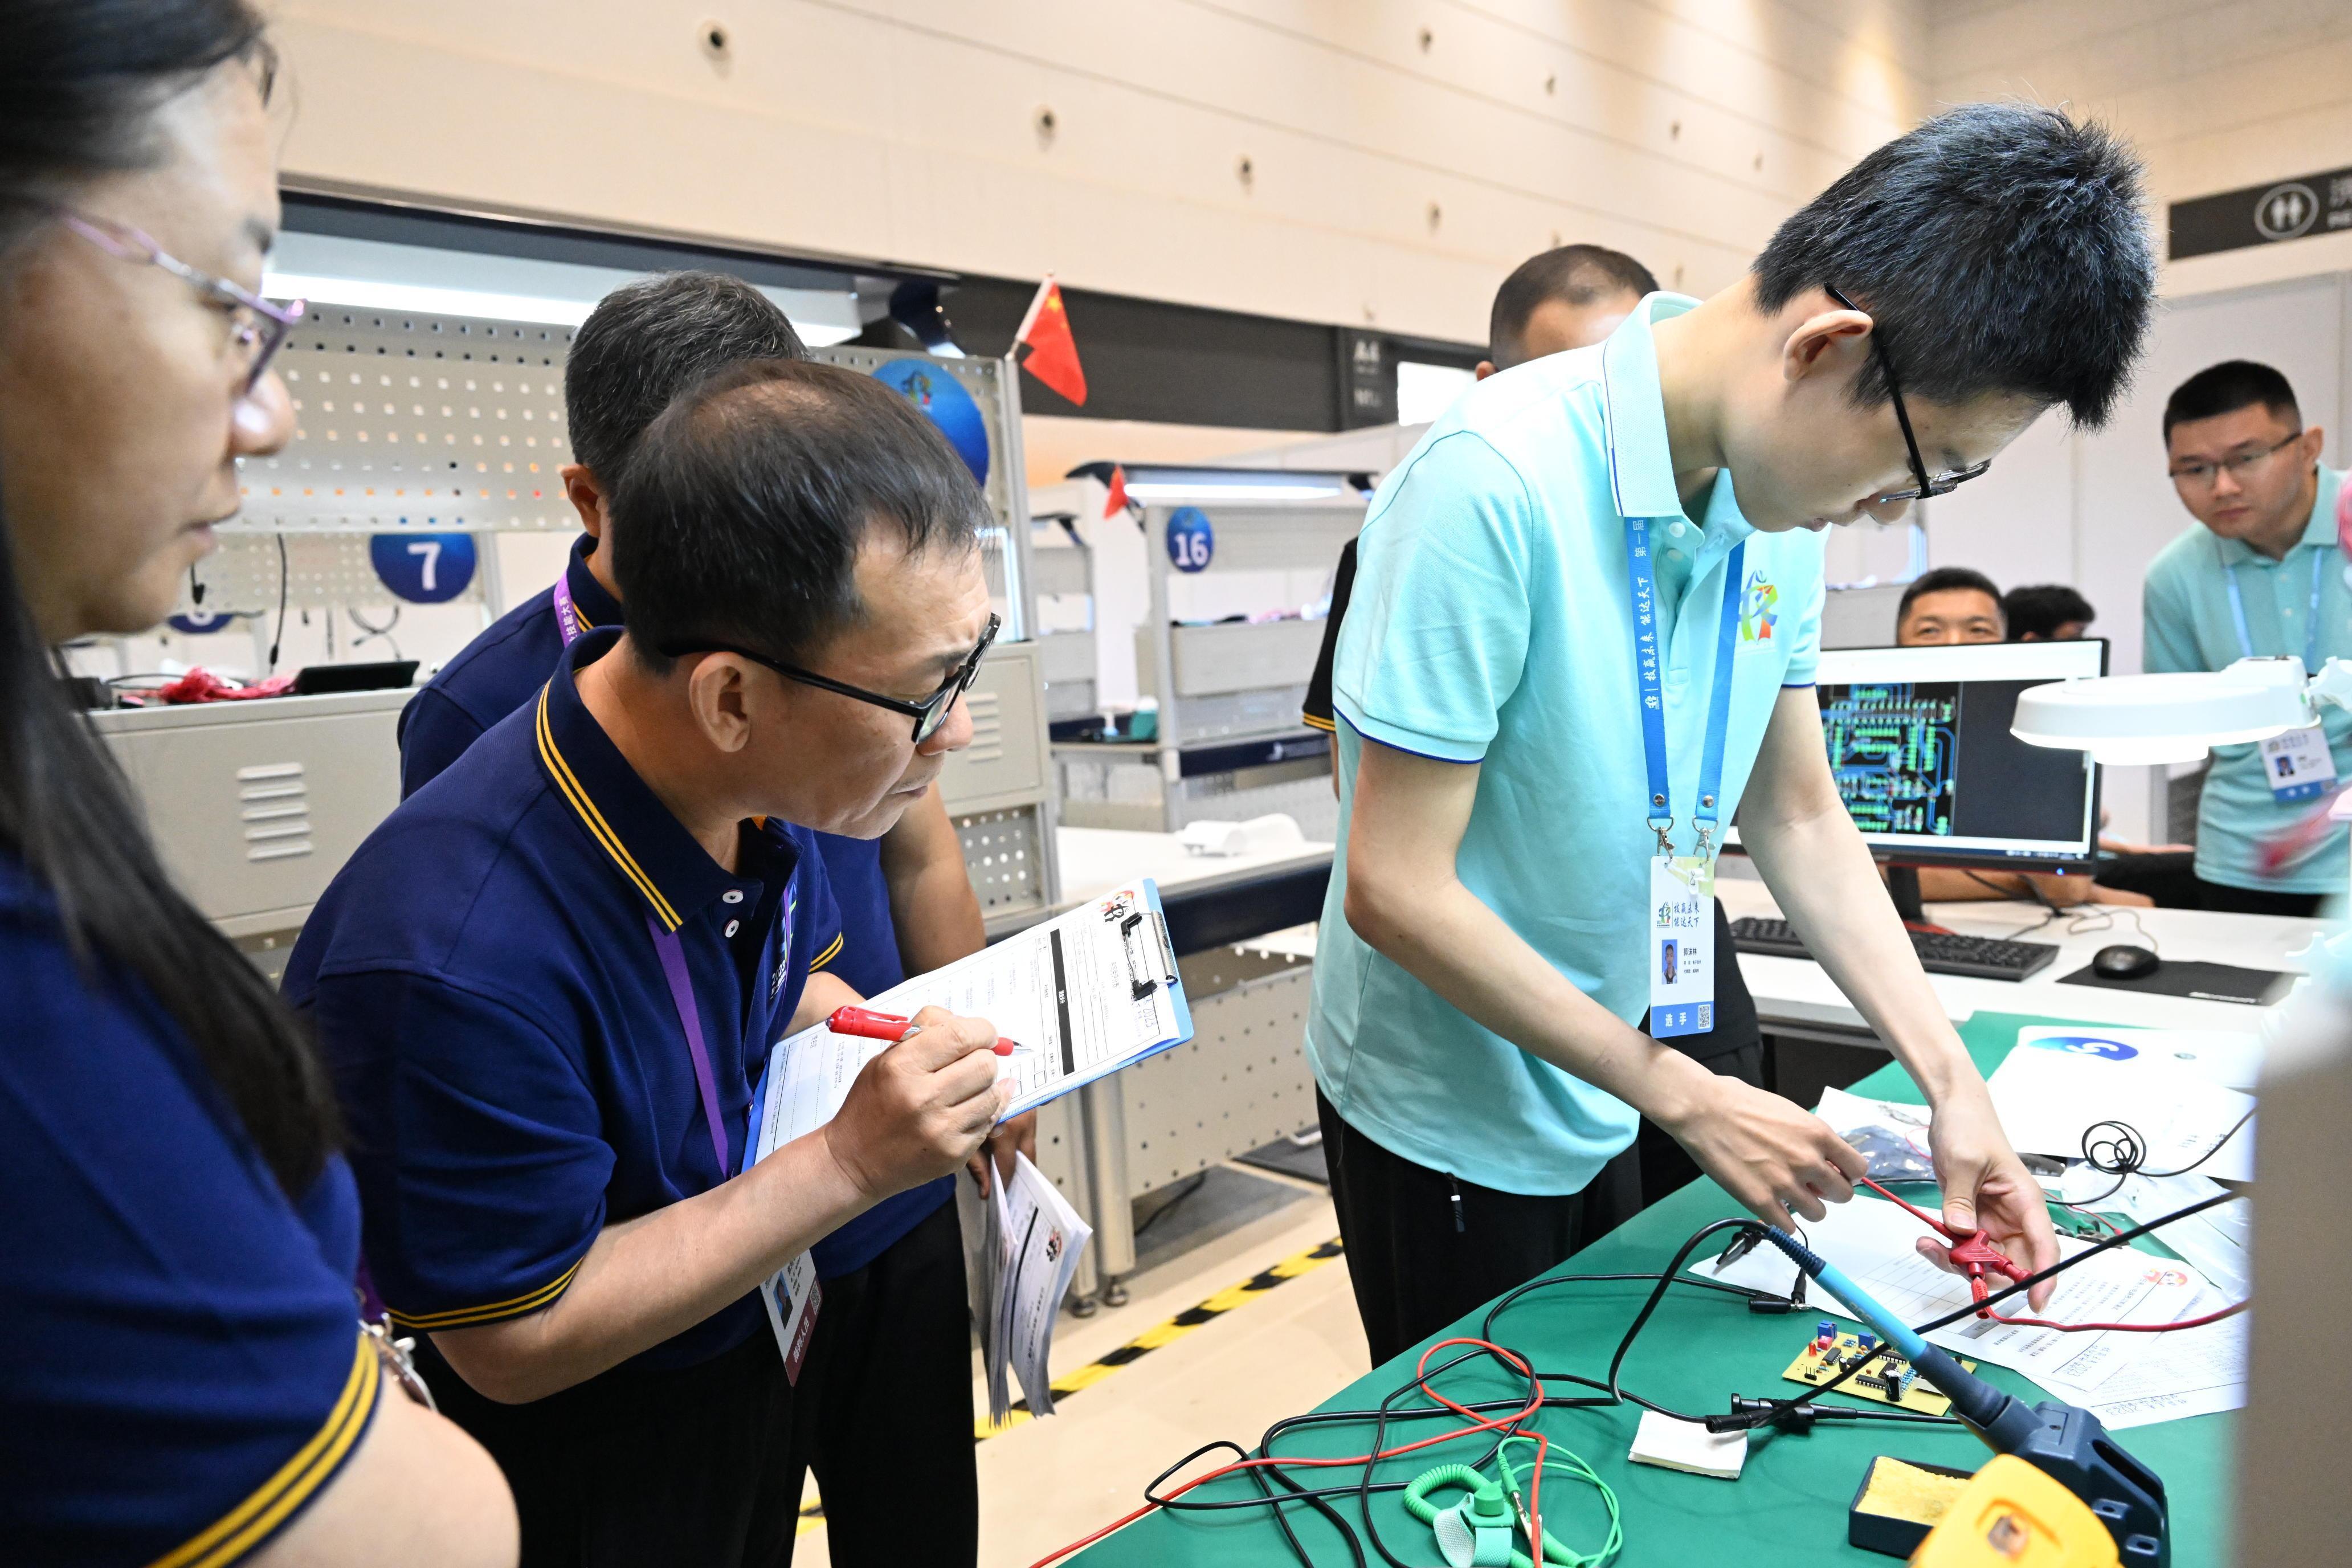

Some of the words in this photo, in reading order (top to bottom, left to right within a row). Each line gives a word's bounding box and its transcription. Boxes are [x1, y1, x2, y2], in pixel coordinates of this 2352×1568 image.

[1174, 531, 1209, 566] 16
[1632, 518, 1647, 557] 第一届
[407, 541, 442, 591] 7
[771, 959, 786, 986] 2023
[1665, 1011, 1688, 1027] 选手
